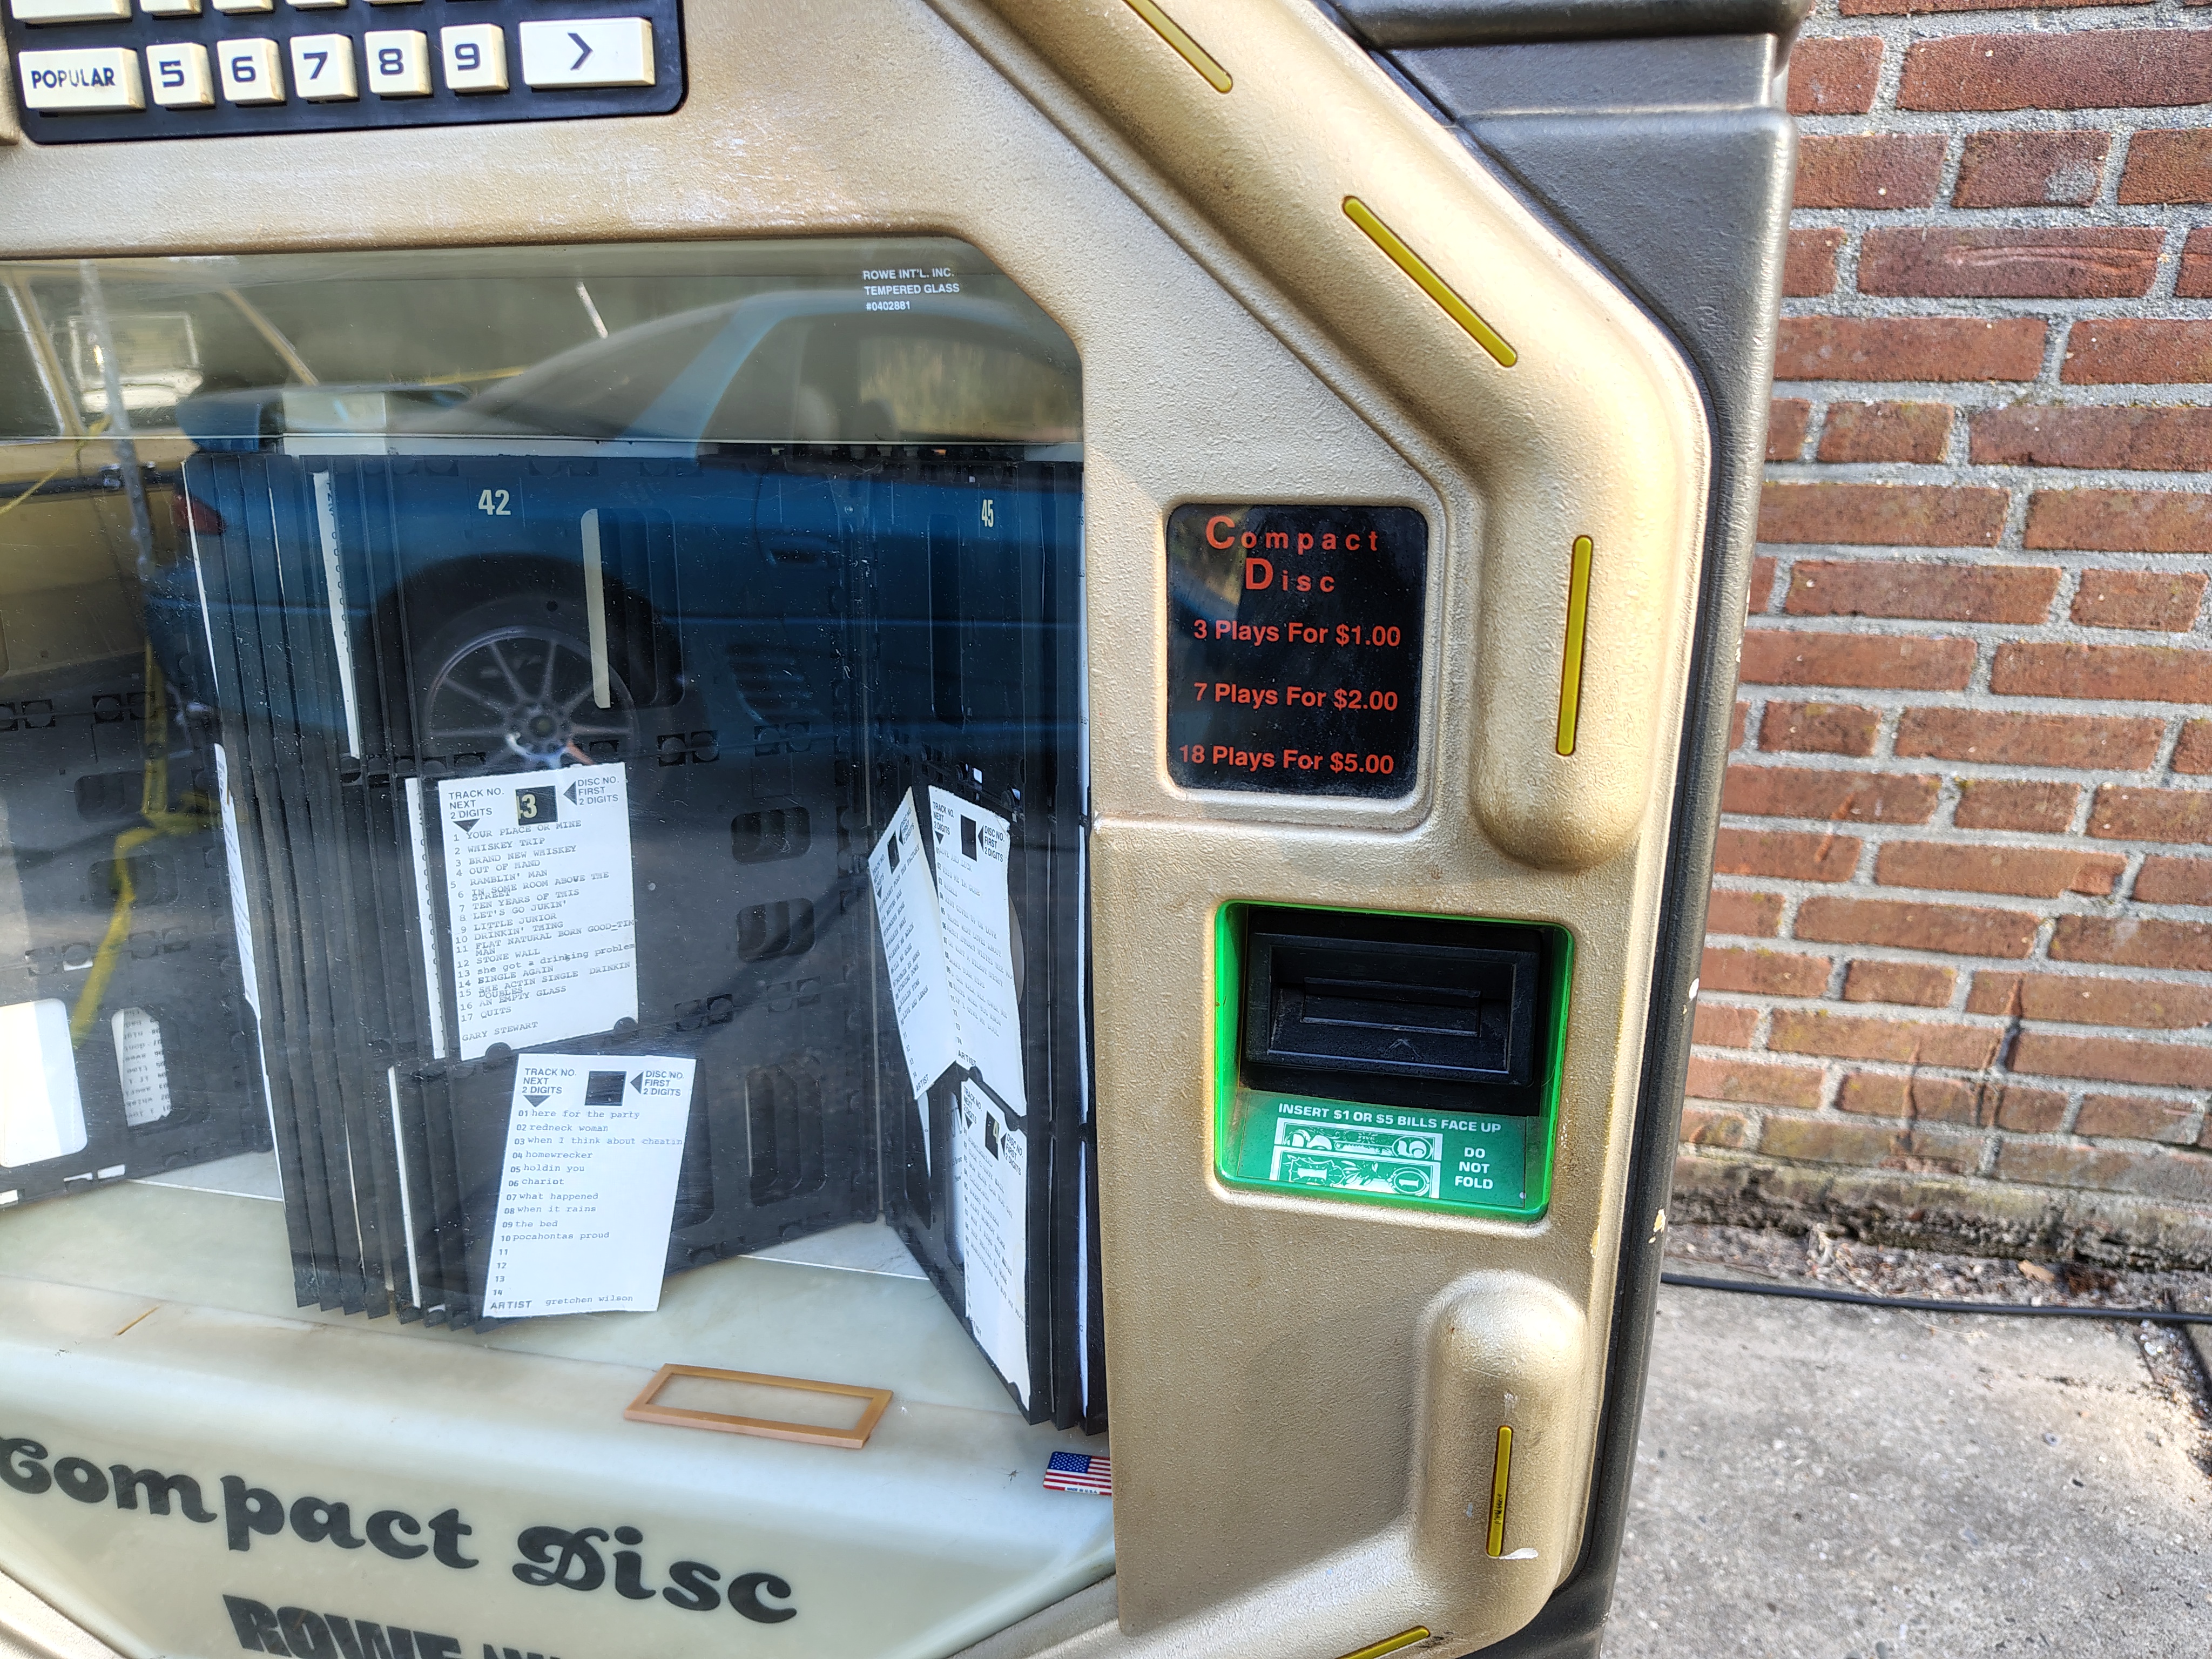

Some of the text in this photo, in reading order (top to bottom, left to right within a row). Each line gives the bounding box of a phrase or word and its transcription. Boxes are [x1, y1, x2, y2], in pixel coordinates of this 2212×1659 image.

[379, 48, 404, 76] 8
[455, 43, 481, 71] 9
[159, 60, 185, 87] 5
[232, 56, 256, 83] 6
[303, 52, 328, 80] 7
[31, 67, 115, 89] POPULAR
[862, 268, 954, 280] ROWE INT'L. INC.
[864, 283, 960, 296] TEMPERED GLASS
[866, 301, 911, 311] #0402881
[478, 489, 511, 515] 42
[981, 499, 994, 528] 45
[1205, 515, 1378, 555] Compact
[1245, 557, 1336, 592] Disc
[1193, 619, 1401, 646] 3 Plays For $1.00
[1194, 683, 1398, 711] 7 Plays For $2.00
[1179, 744, 1394, 774] 18 Plays For $5.00
[578, 776, 619, 787] DISC NO.
[449, 787, 504, 800] TRACK NO.
[578, 786, 606, 795] FIRST
[450, 800, 476, 810] NEXT
[587, 795, 619, 804] DIGITS
[933, 801, 946, 814] TRACK
[459, 808, 493, 818] DIGITS
[933, 811, 944, 822] NEXT
[467, 830, 493, 839] YOUR
[500, 826, 531, 836] PLACE
[556, 820, 582, 830] MINE
[937, 823, 950, 835] DIGITS
[984, 826, 1004, 842] DISC NO.
[468, 837, 545, 853] WHISKEY TRIP
[984, 837, 997, 849] FIRST
[469, 845, 577, 865] BRAND NEW WHISKEY
[988, 849, 1003, 862] DIGITS
[469, 859, 541, 875] OUT OF HAND
[470, 870, 548, 886] RAMBLIN' MAN
[491, 884, 517, 894] SOME
[523, 880, 549, 889] ROOM
[555, 875, 585, 885] ABOVE
[591, 872, 610, 880] THE
[473, 889, 580, 910] TEN YEARS OF THIS
[473, 900, 567, 920] LET'S GO JUKIN'
[474, 913, 557, 931] LITTLE JUNIOR
[474, 922, 564, 941] DRINKIN' THING
[475, 940, 502, 950] FLAT
[508, 933, 552, 945] NATURAL
[558, 928, 582, 938] BORN
[475, 948, 496, 956] MAN
[476, 948, 541, 965] STONE WALL
[477, 966, 497, 975] she
[502, 962, 521, 972] got
[595, 943, 635, 957] problem
[478, 966, 554, 984] SINGLE AGAIN
[504, 978, 536, 990] ACTIN
[542, 971, 579, 983] SINGLE
[589, 961, 631, 974] DRINKIN
[536, 986, 567, 997] GLASS
[481, 1007, 512, 1019] QUITS
[462, 1021, 538, 1041] GARY STEWART
[958, 1050, 976, 1066] ARTIST
[525, 1068, 577, 1076] TRACK NO.
[611, 1111, 640, 1120] party
[1278, 1103, 1501, 1133] INSERT $1 OR $5 BILLS FACE UP
[1007, 1134, 1016, 1149] DISC
[525, 1150, 594, 1158] homewrecker
[1006, 1144, 1017, 1160] FIRST
[1464, 1148, 1486, 1158] DO
[567, 1165, 585, 1174] you
[1008, 1156, 1021, 1176] DIGITS
[1459, 1161, 1490, 1174] NOT
[1454, 1175, 1493, 1189] FOLD
[550, 1192, 599, 1201] happened
[513, 1232, 610, 1241] pocahontas proud
[490, 1300, 532, 1310] ARTIST
[545, 1297, 593, 1306] gretchen
[0, 1437, 798, 1626] Compact Disc
